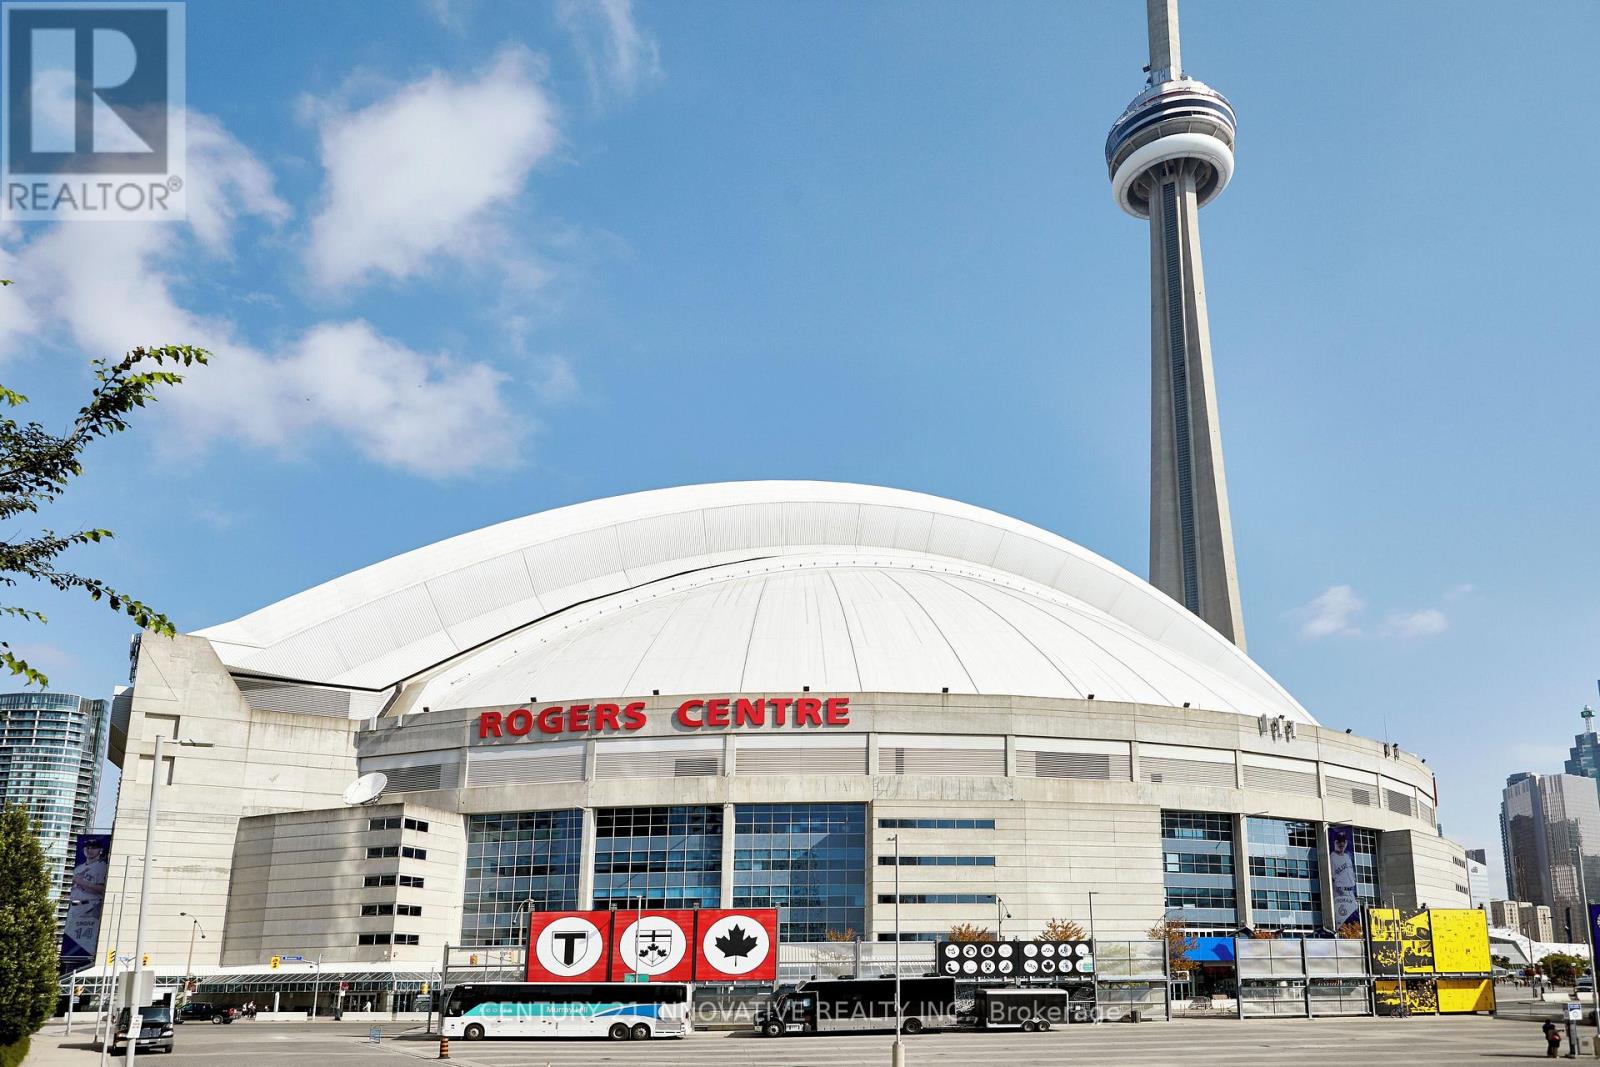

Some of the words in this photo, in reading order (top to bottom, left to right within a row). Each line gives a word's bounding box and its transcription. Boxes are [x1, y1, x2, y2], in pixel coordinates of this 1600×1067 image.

[479, 701, 647, 739] ROGERS
[676, 697, 851, 728] CENTRE
[74, 927, 94, 940] 14
[554, 932, 587, 967] T
